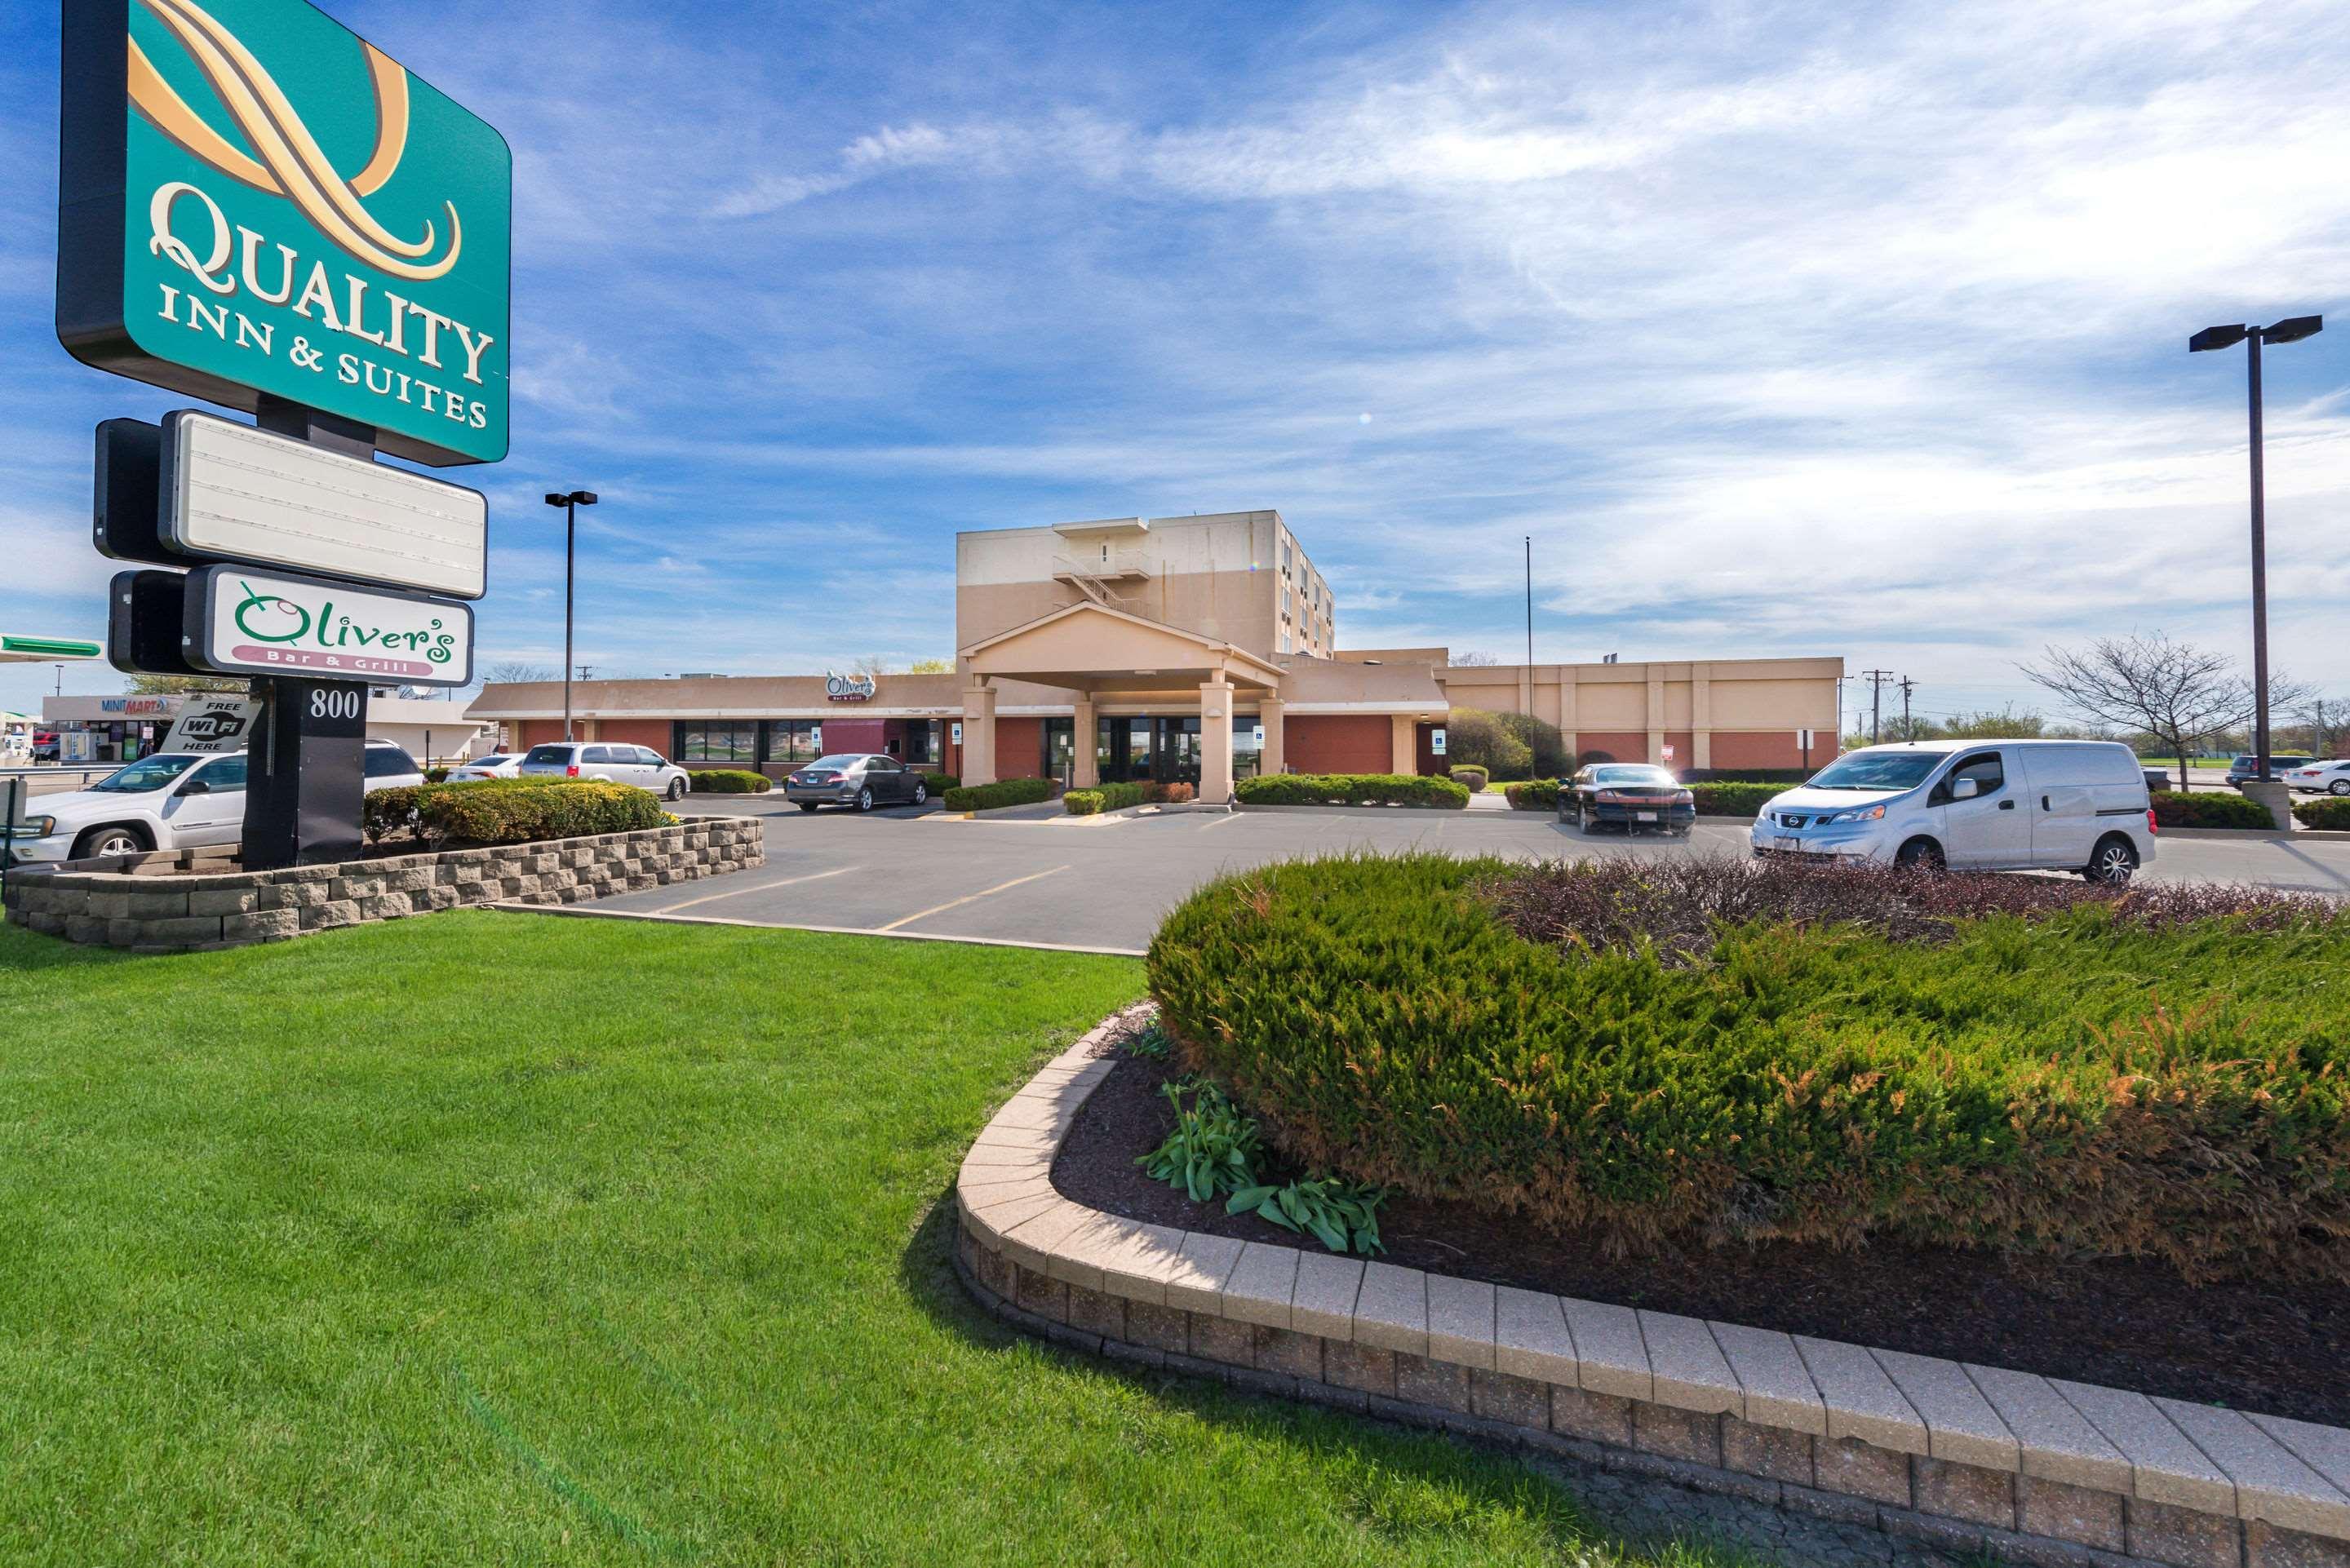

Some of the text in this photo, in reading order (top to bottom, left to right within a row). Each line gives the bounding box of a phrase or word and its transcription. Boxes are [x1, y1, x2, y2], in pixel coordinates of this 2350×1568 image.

[150, 182, 494, 385] QUALITY
[158, 283, 487, 429] INN & SUITES
[234, 594, 455, 663] Oliver's
[267, 650, 407, 673] Bar & Grill
[206, 702, 242, 711] FREE
[310, 689, 359, 719] 800
